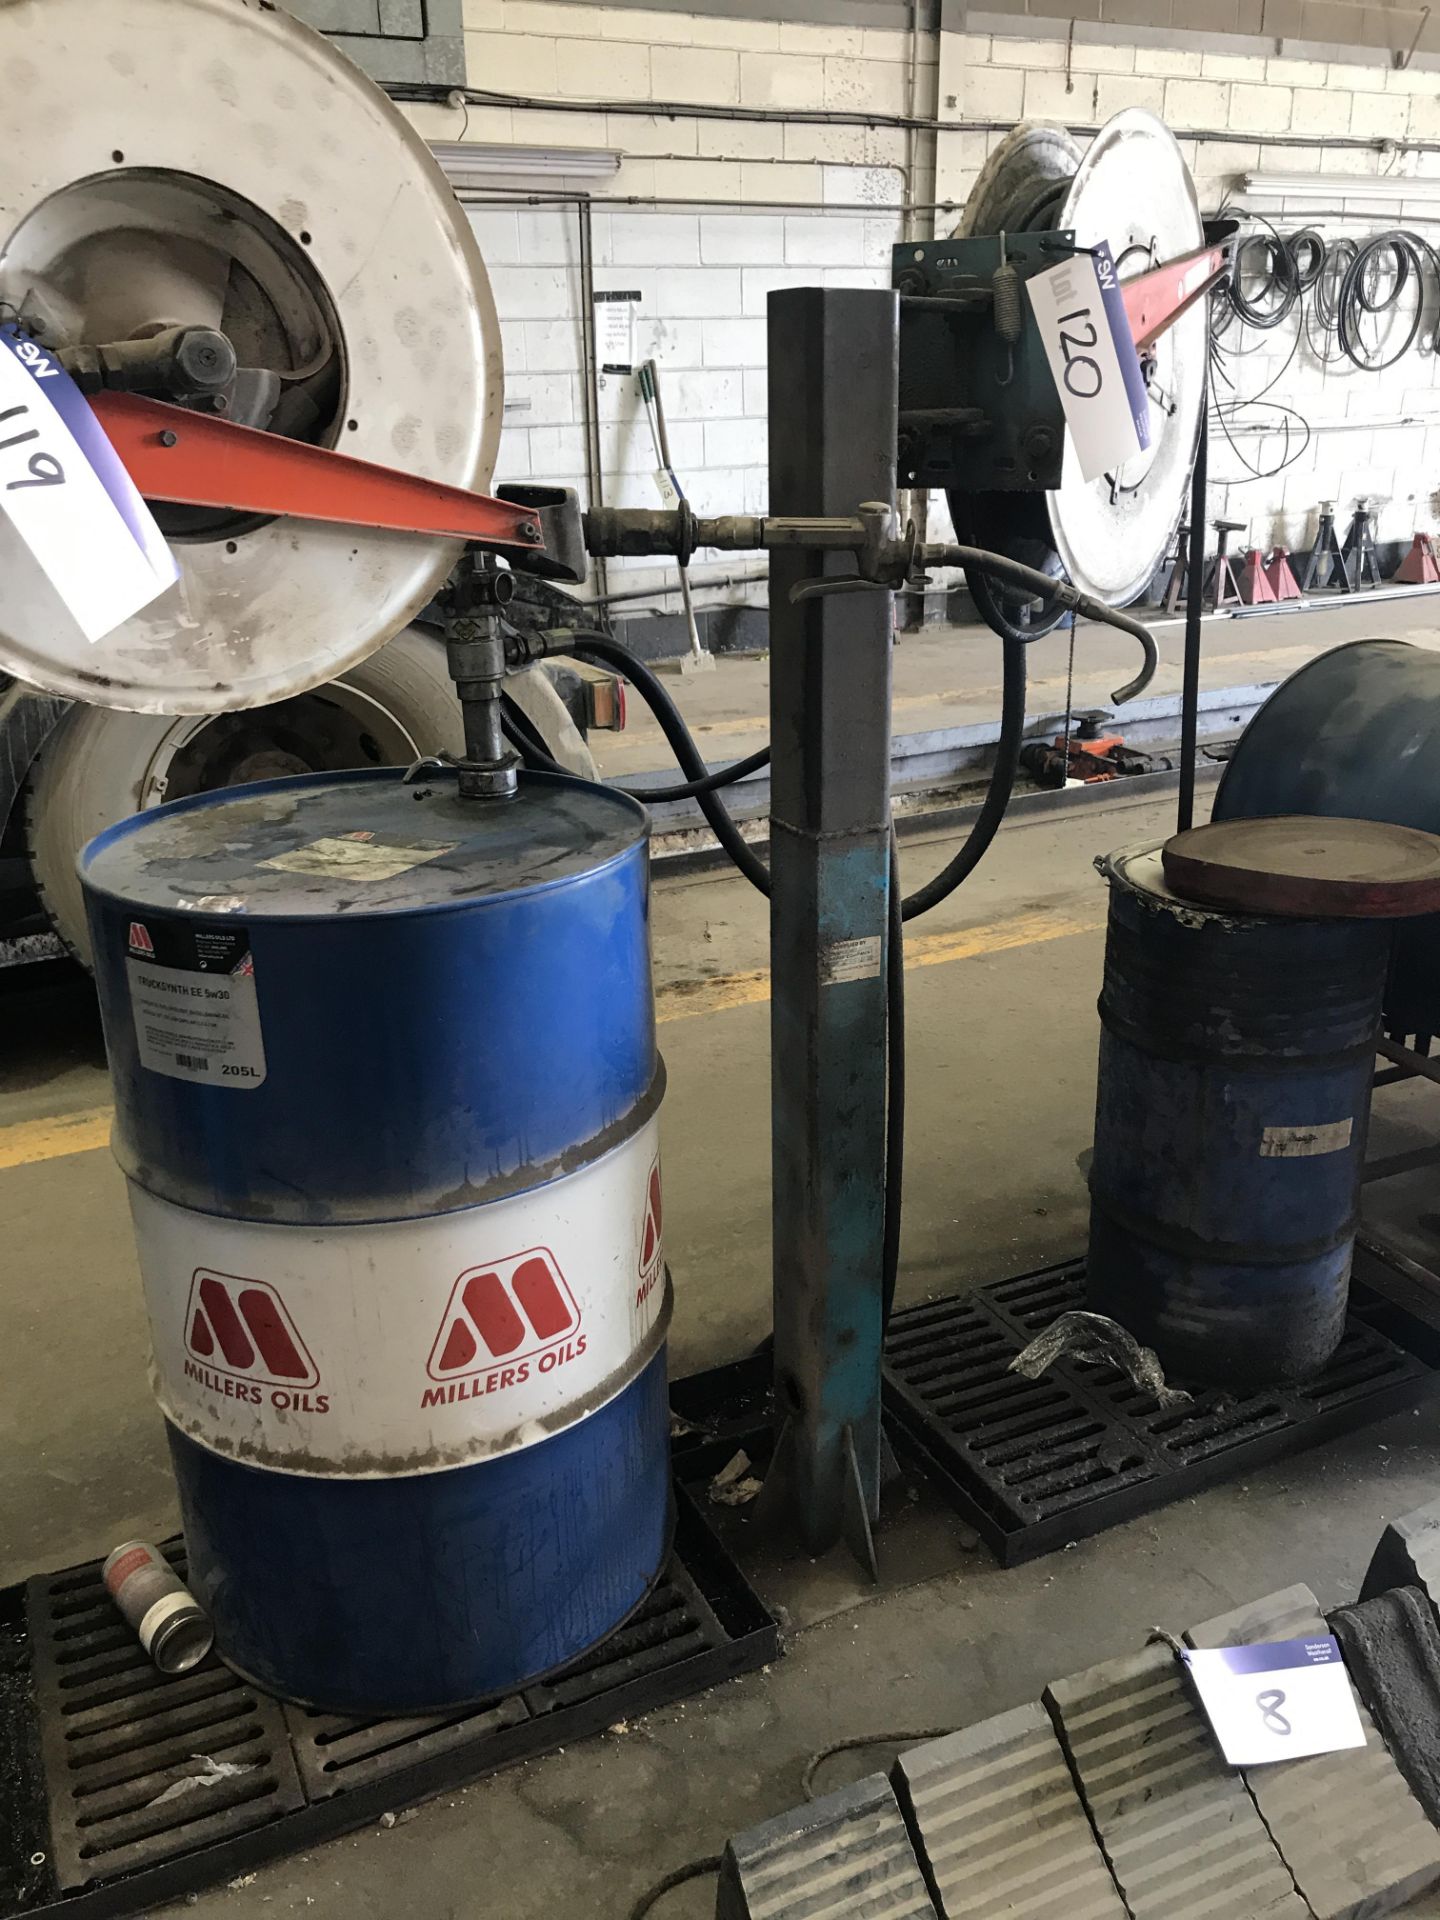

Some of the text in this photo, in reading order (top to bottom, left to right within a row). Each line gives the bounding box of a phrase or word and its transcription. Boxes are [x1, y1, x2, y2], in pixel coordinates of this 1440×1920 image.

[1097, 259, 1116, 290] SW
[1048, 266, 1103, 399] Lot 120
[15, 342, 60, 378] SW
[137, 975, 230, 1000] TRUCKSYNTH EE 5w30
[222, 1064, 261, 1078] 205L
[184, 1359, 330, 1414] MILLERS OILS
[420, 1334, 587, 1409] MILLERS OILS
[1256, 1689, 1291, 1735] 8
